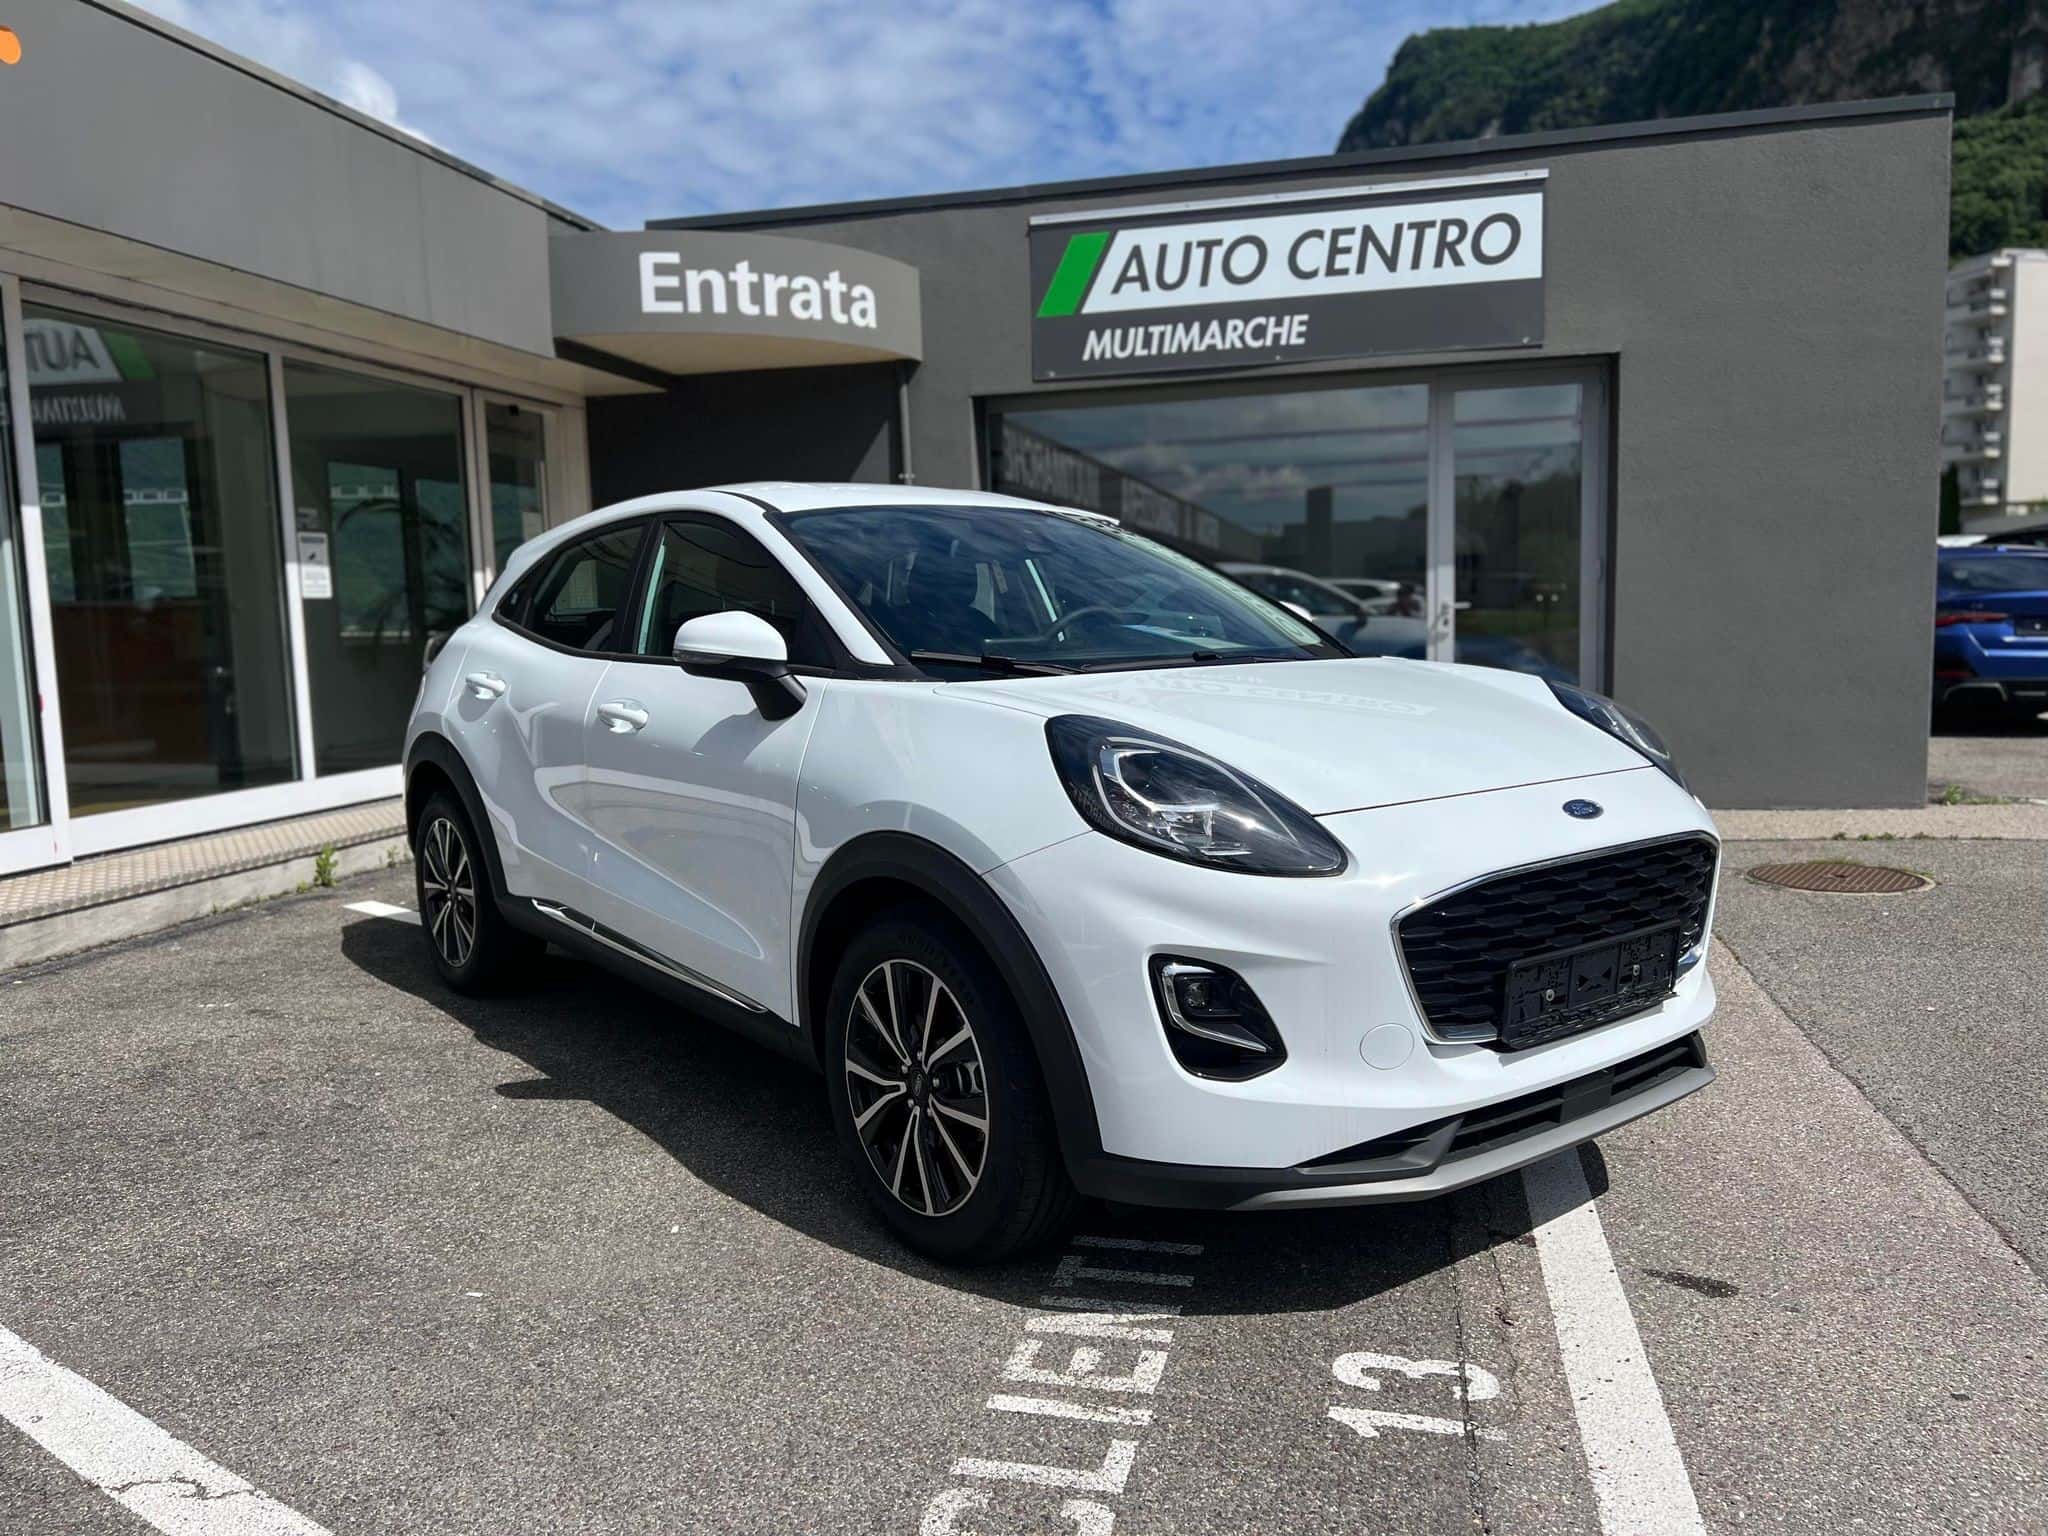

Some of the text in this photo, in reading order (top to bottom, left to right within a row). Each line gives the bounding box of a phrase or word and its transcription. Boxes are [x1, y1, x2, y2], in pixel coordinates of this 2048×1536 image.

[639, 251, 878, 329] Entrata
[1110, 212, 1522, 295] AUTO CENTRO
[1082, 313, 1310, 361] MULTIMARCHE
[1327, 1351, 1507, 1438] 13
